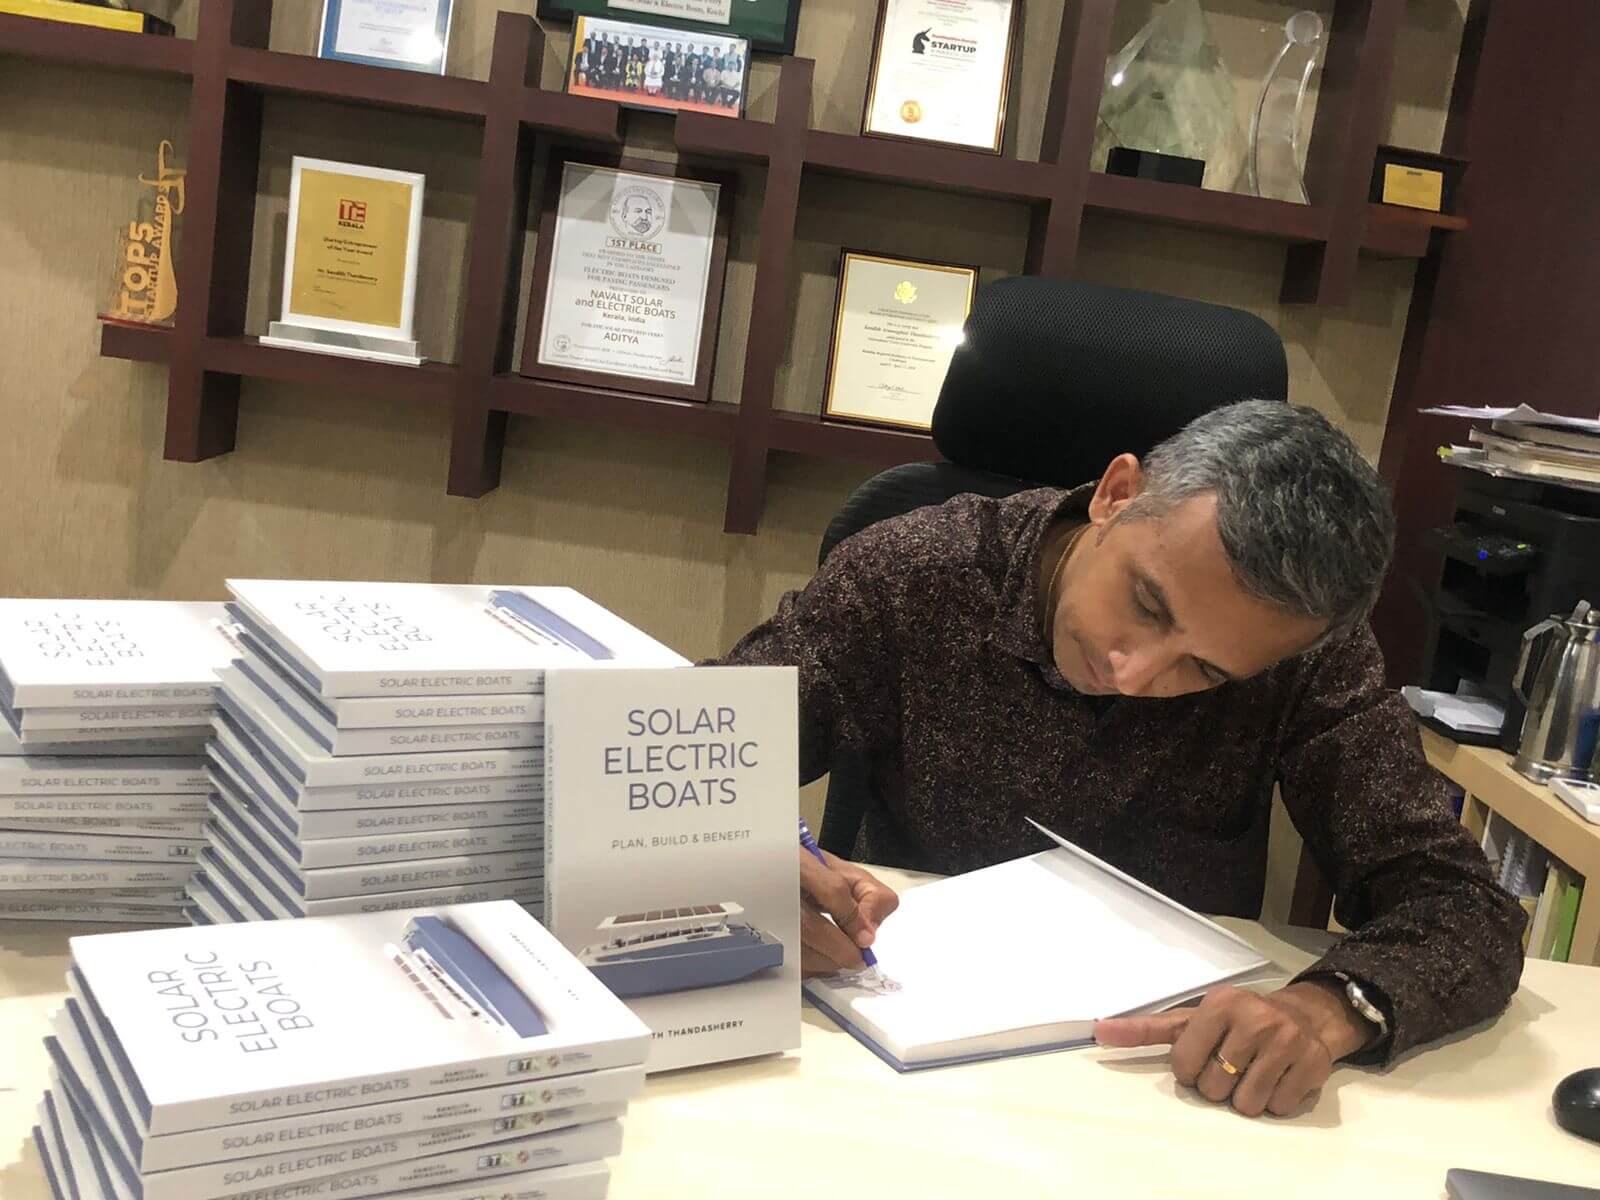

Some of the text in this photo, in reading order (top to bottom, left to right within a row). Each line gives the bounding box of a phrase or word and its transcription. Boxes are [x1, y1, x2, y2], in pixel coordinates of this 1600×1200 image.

[931, 41, 976, 54] STARTUP
[338, 221, 364, 230] KERALA
[611, 239, 658, 253] 1ST PLACE
[590, 289, 664, 308] NAVALT SOLAR
[575, 298, 676, 320] and ELECTRIC BOATS
[604, 332, 640, 345] ADITYA
[379, 676, 513, 688] SOLAR ELECTRIC BOATS
[395, 705, 527, 719] SOLAR ELECTRIC BOATS
[627, 707, 736, 737] SOLAR
[390, 731, 521, 745] SOLAR ELECTRIC BOATS
[605, 741, 759, 775] ELECTRIC
[364, 760, 497, 777] SOLAR ELECTRIC BOATS
[21, 777, 161, 787] SOLAR ELECTRIC BOATS
[357, 784, 491, 801] SOLAR ELECTRIC BOATS
[629, 778, 737, 811] BOATS
[357, 811, 489, 828] SOLAR ELECTRIC BOATS
[357, 837, 488, 857] SOLAR ELECTRIC BOATS
[612, 829, 752, 850] PLAN, BUILD & BENEFIT
[360, 865, 491, 887] SOLAR ELECTRIC BOATS
[184, 952, 279, 1053] ELECTRIC
[238, 960, 315, 1031] BOATS
[147, 969, 219, 1043] SOLAR
[668, 1020, 744, 1038] THANDASHERRY
[230, 1077, 411, 1115] SOLAR ELECTRIC BOATS
[222, 1112, 403, 1150] SOLAR ELECTRIC BOATS
[223, 1141, 399, 1186] SOLAR ELECTRIC BOATS
[330, 1174, 379, 1192] BOATS
